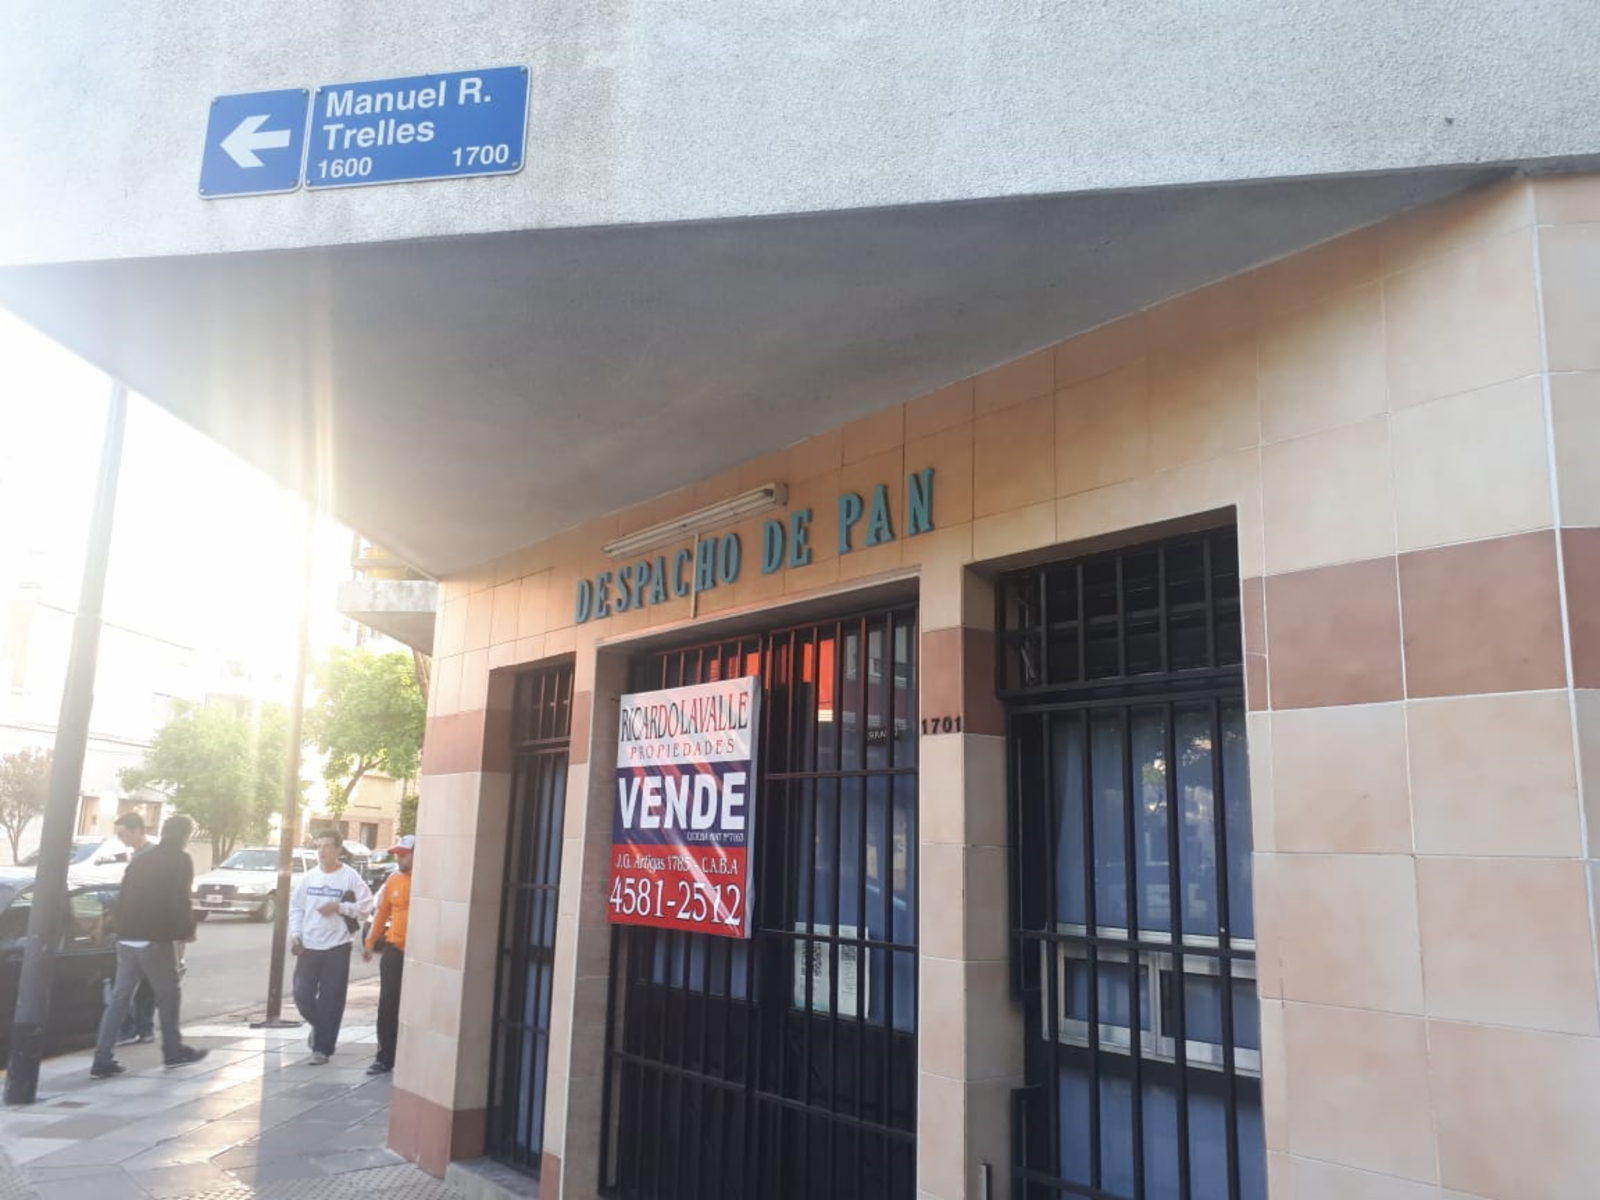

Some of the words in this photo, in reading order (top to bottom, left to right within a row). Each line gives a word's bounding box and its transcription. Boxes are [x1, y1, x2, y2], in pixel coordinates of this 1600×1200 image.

[325, 80, 446, 118] Manuel
[457, 77, 492, 105] R.
[322, 119, 435, 150] Trelles
[318, 156, 373, 179] 1600
[451, 143, 510, 167] 1700
[575, 532, 743, 624] DESPACHO
[761, 508, 813, 575] DE
[837, 467, 936, 555] PAN
[921, 715, 961, 735] 1701
[630, 738, 735, 760] PROPIEDADES
[617, 771, 746, 830] VENDE
[633, 854, 666, 873] Artigas
[609, 875, 741, 926] 4581-2512
